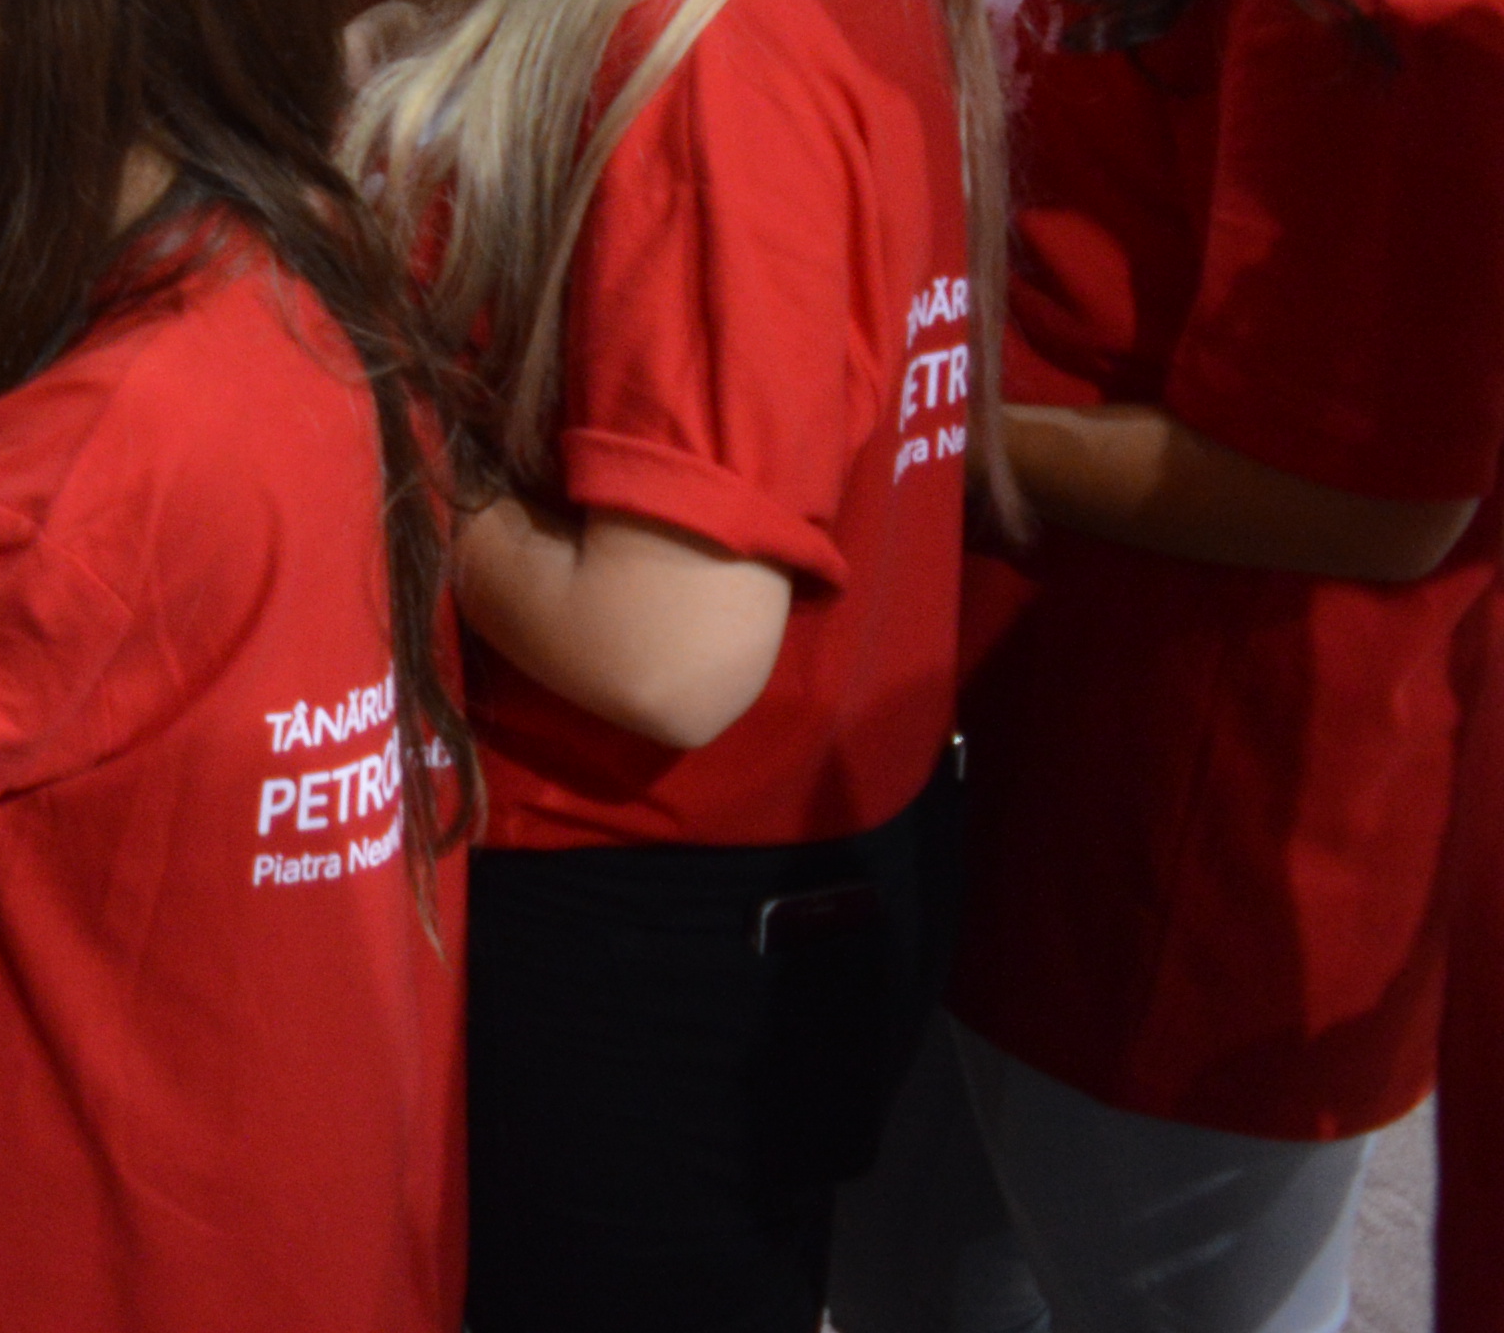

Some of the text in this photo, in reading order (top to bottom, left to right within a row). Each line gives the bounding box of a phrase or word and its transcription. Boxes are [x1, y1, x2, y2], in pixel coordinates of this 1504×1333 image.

[899, 344, 969, 434] ETR
[264, 663, 397, 754] TÂNĂRU
[257, 725, 405, 837] PETRO
[252, 850, 342, 887] Piatra
